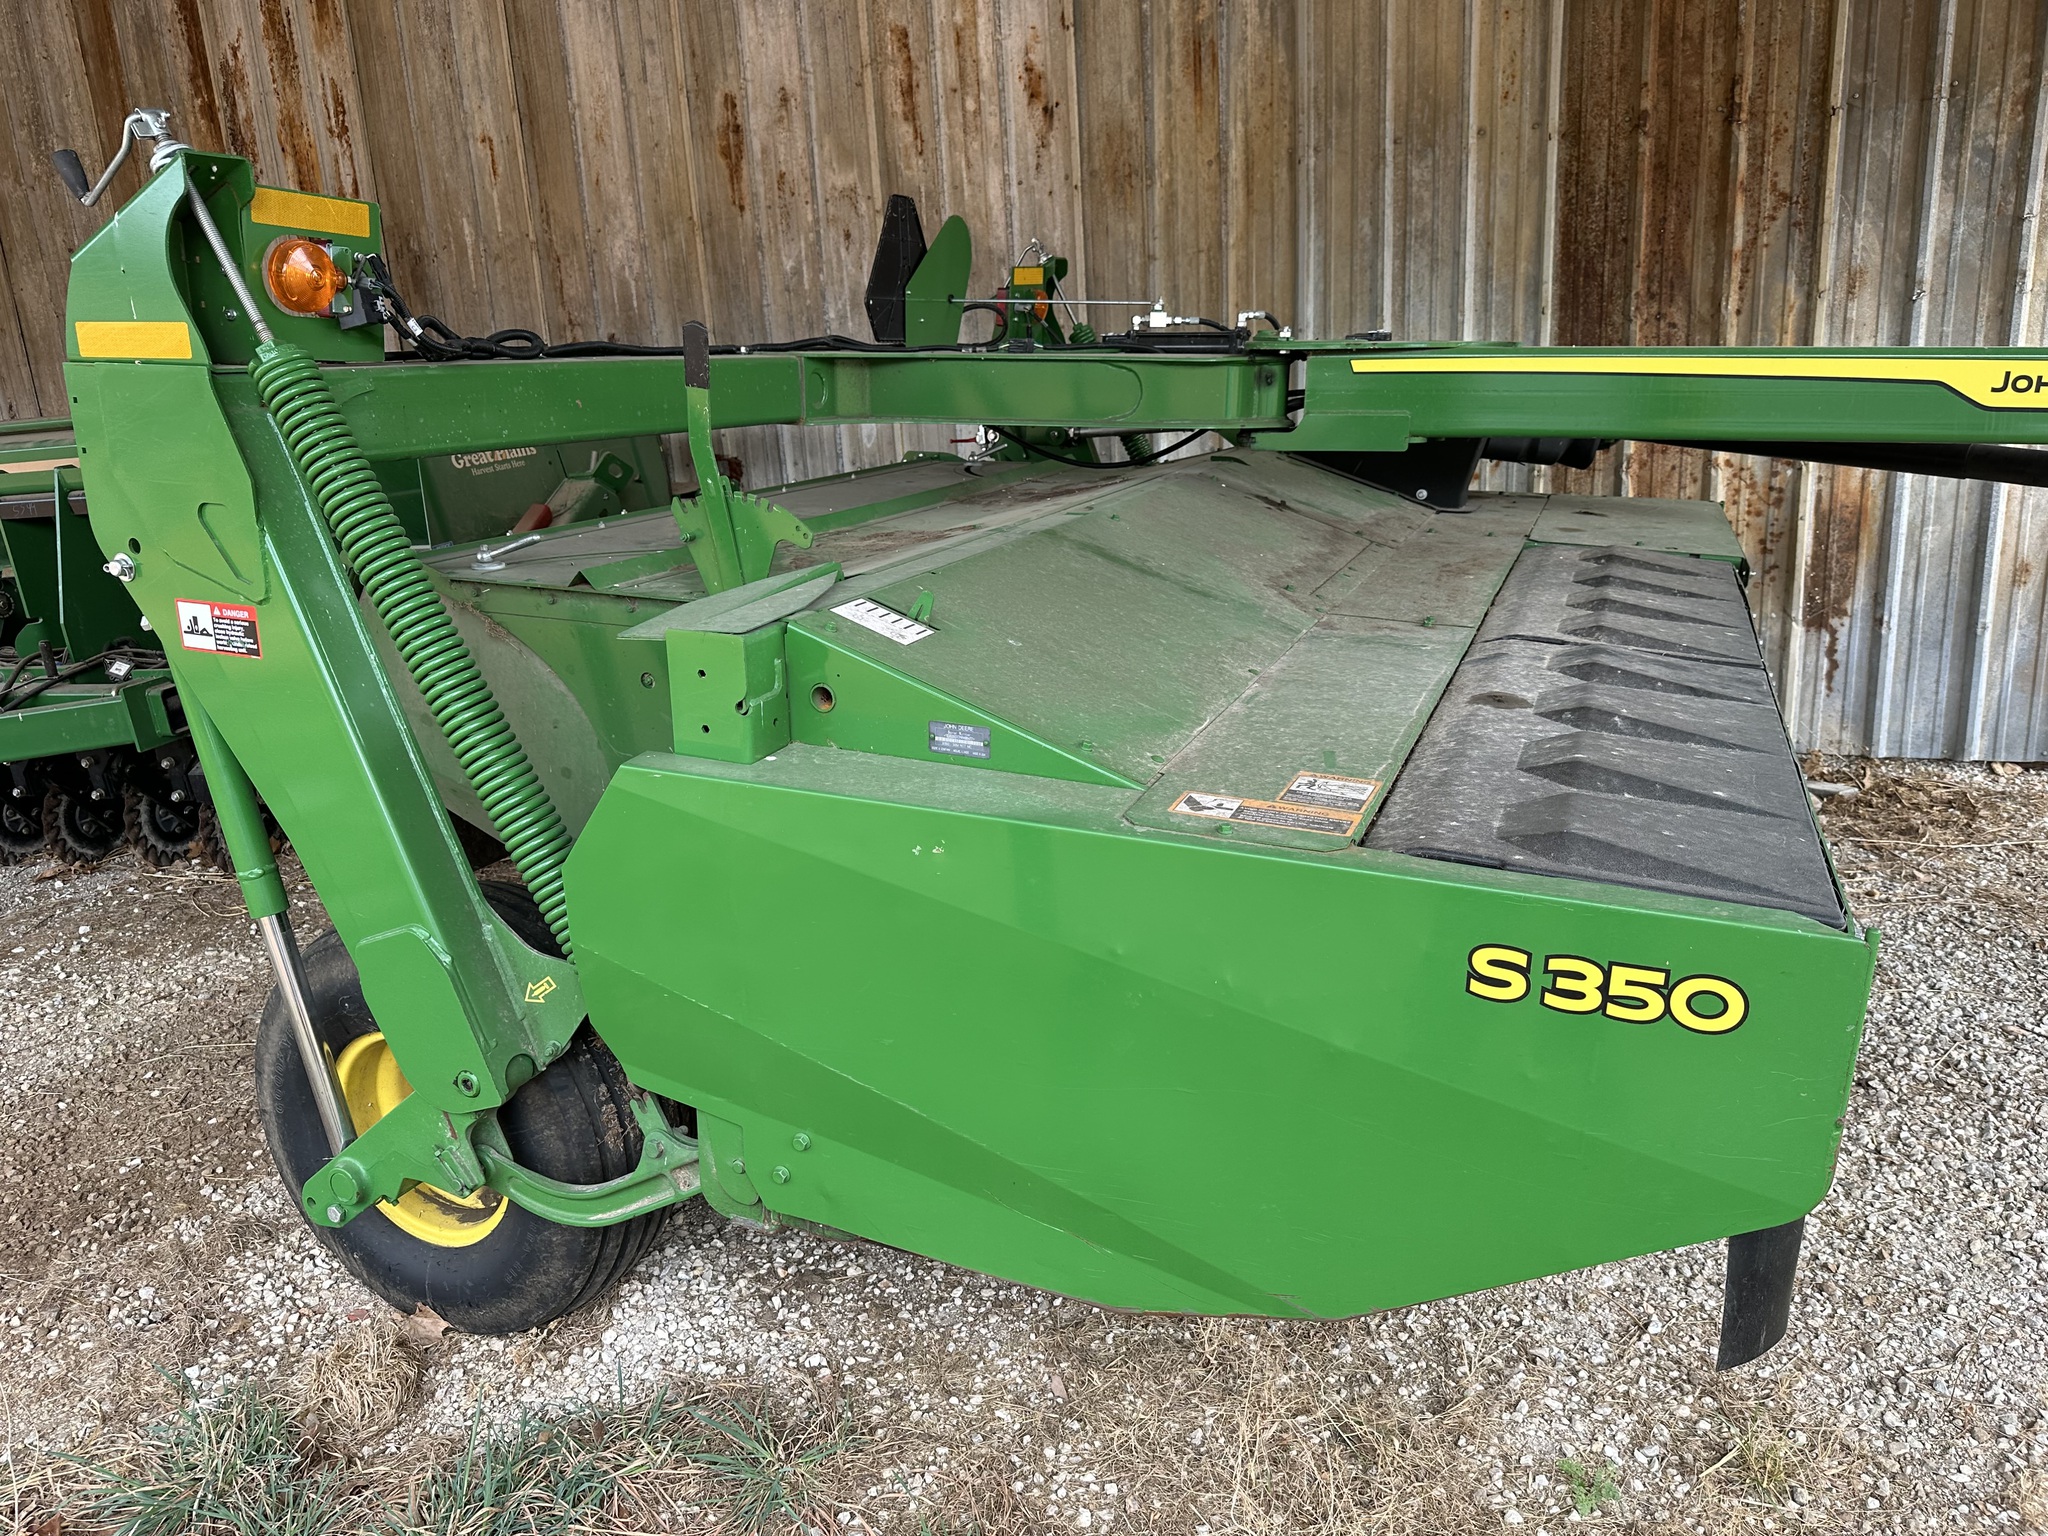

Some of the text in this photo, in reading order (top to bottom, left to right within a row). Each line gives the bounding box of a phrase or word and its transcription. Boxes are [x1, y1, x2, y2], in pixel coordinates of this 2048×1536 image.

[451, 450, 495, 469] Great
[471, 459, 526, 476] Harvest Starts Here
[222, 608, 249, 618] DANGER
[1317, 774, 1372, 785] WARNING
[1278, 803, 1330, 817] WARNING
[1465, 943, 1750, 1035] S 350
